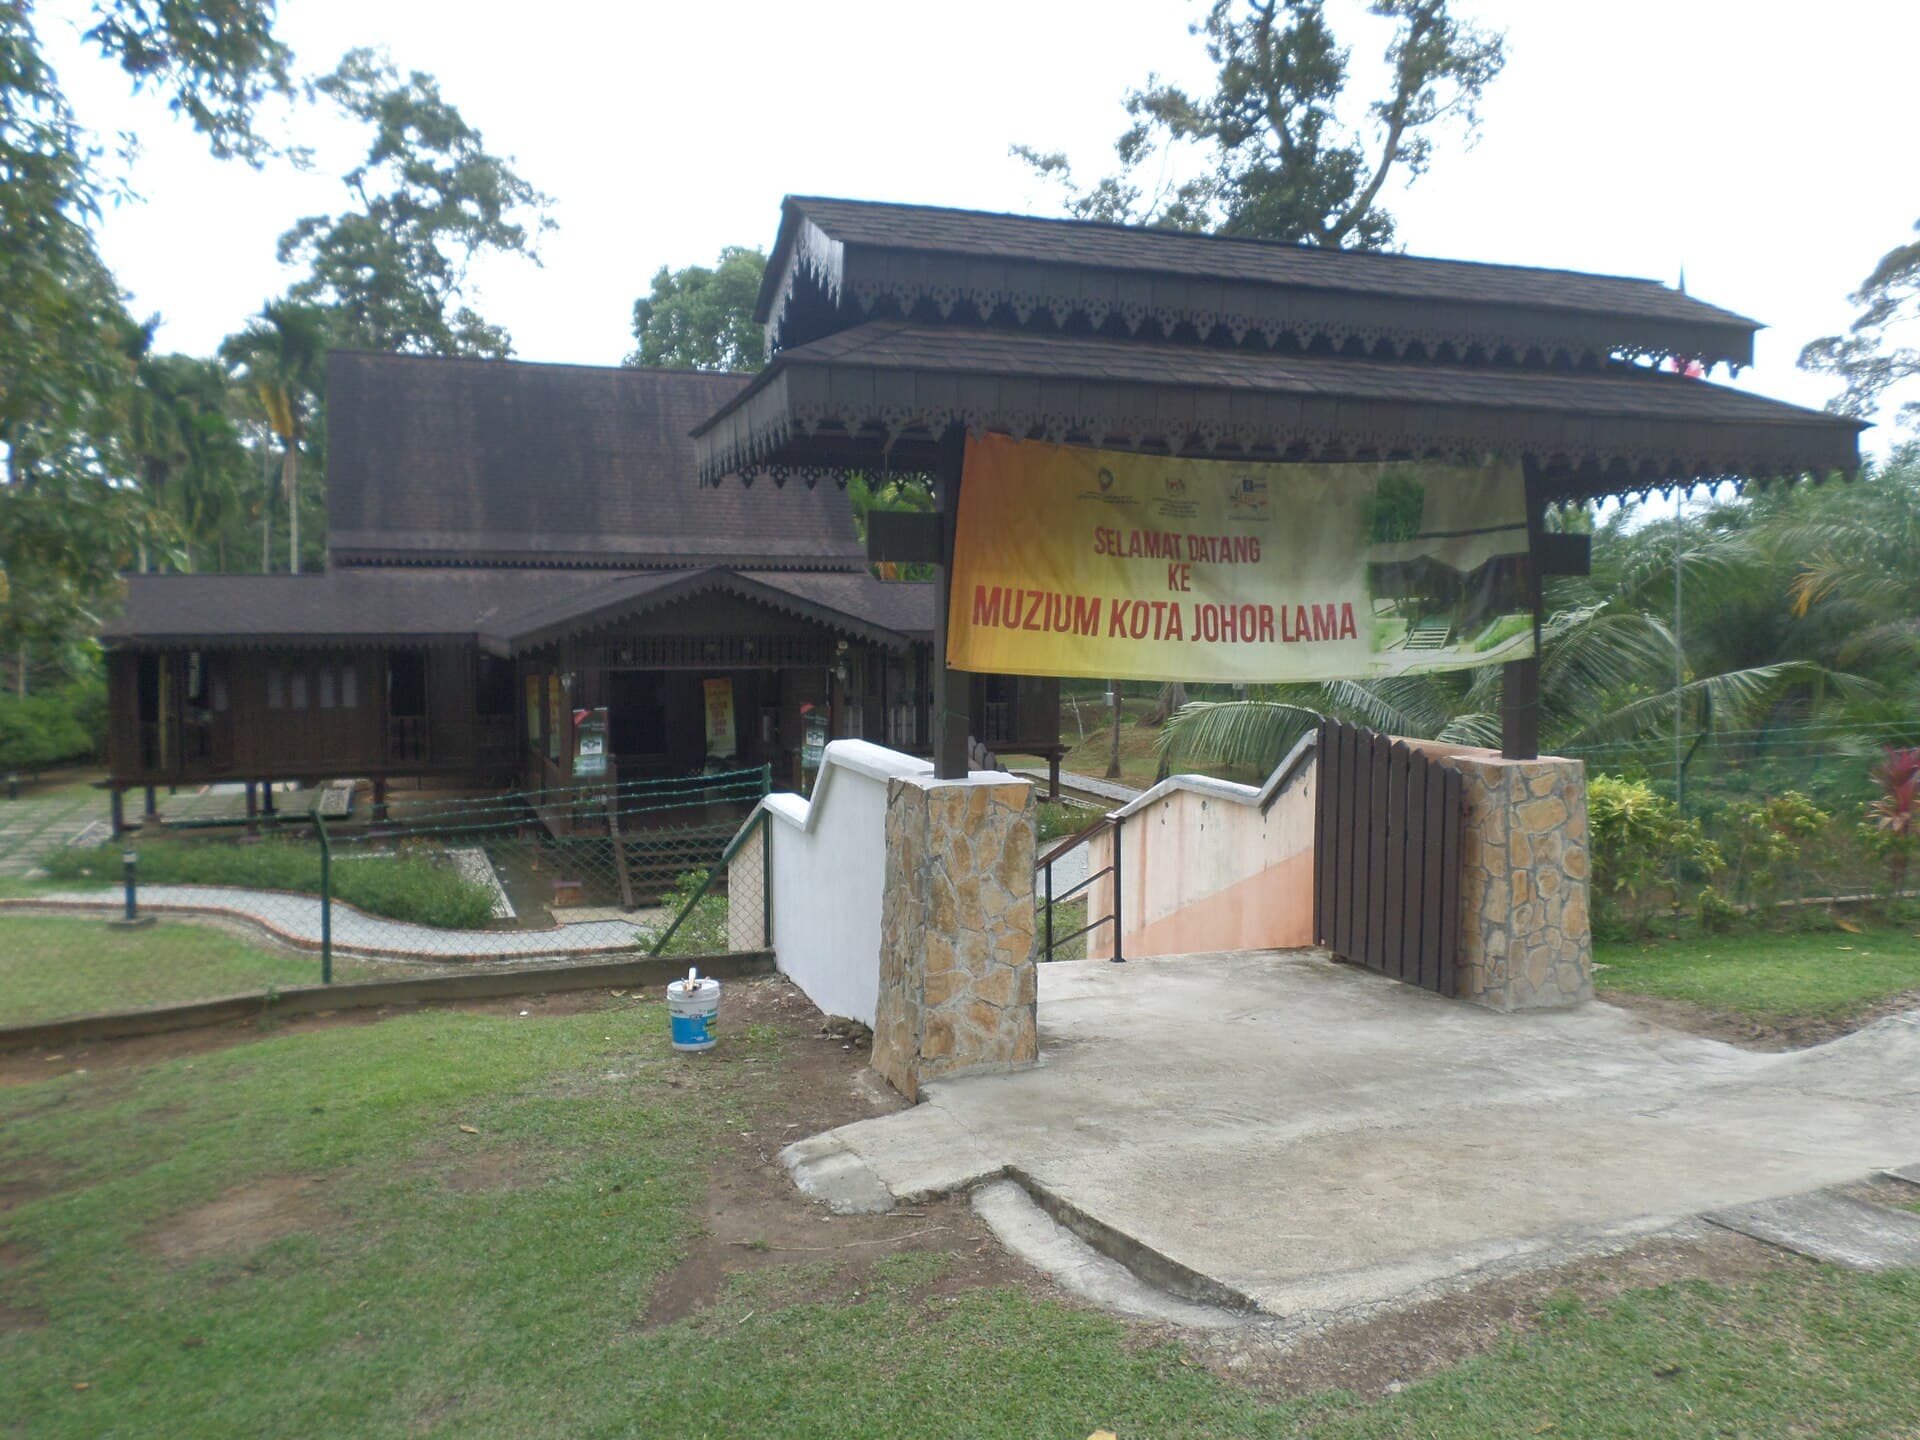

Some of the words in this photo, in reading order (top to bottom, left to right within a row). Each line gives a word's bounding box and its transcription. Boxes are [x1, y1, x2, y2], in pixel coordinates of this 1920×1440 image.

[1094, 526, 1183, 561] SELAMAT
[1187, 533, 1261, 564] DATANG
[1168, 563, 1191, 592] KE
[972, 585, 1102, 637] MUZIUM
[1108, 598, 1183, 641] KOTA
[1191, 603, 1274, 643] JOHOR
[1281, 602, 1357, 642] LAMA
